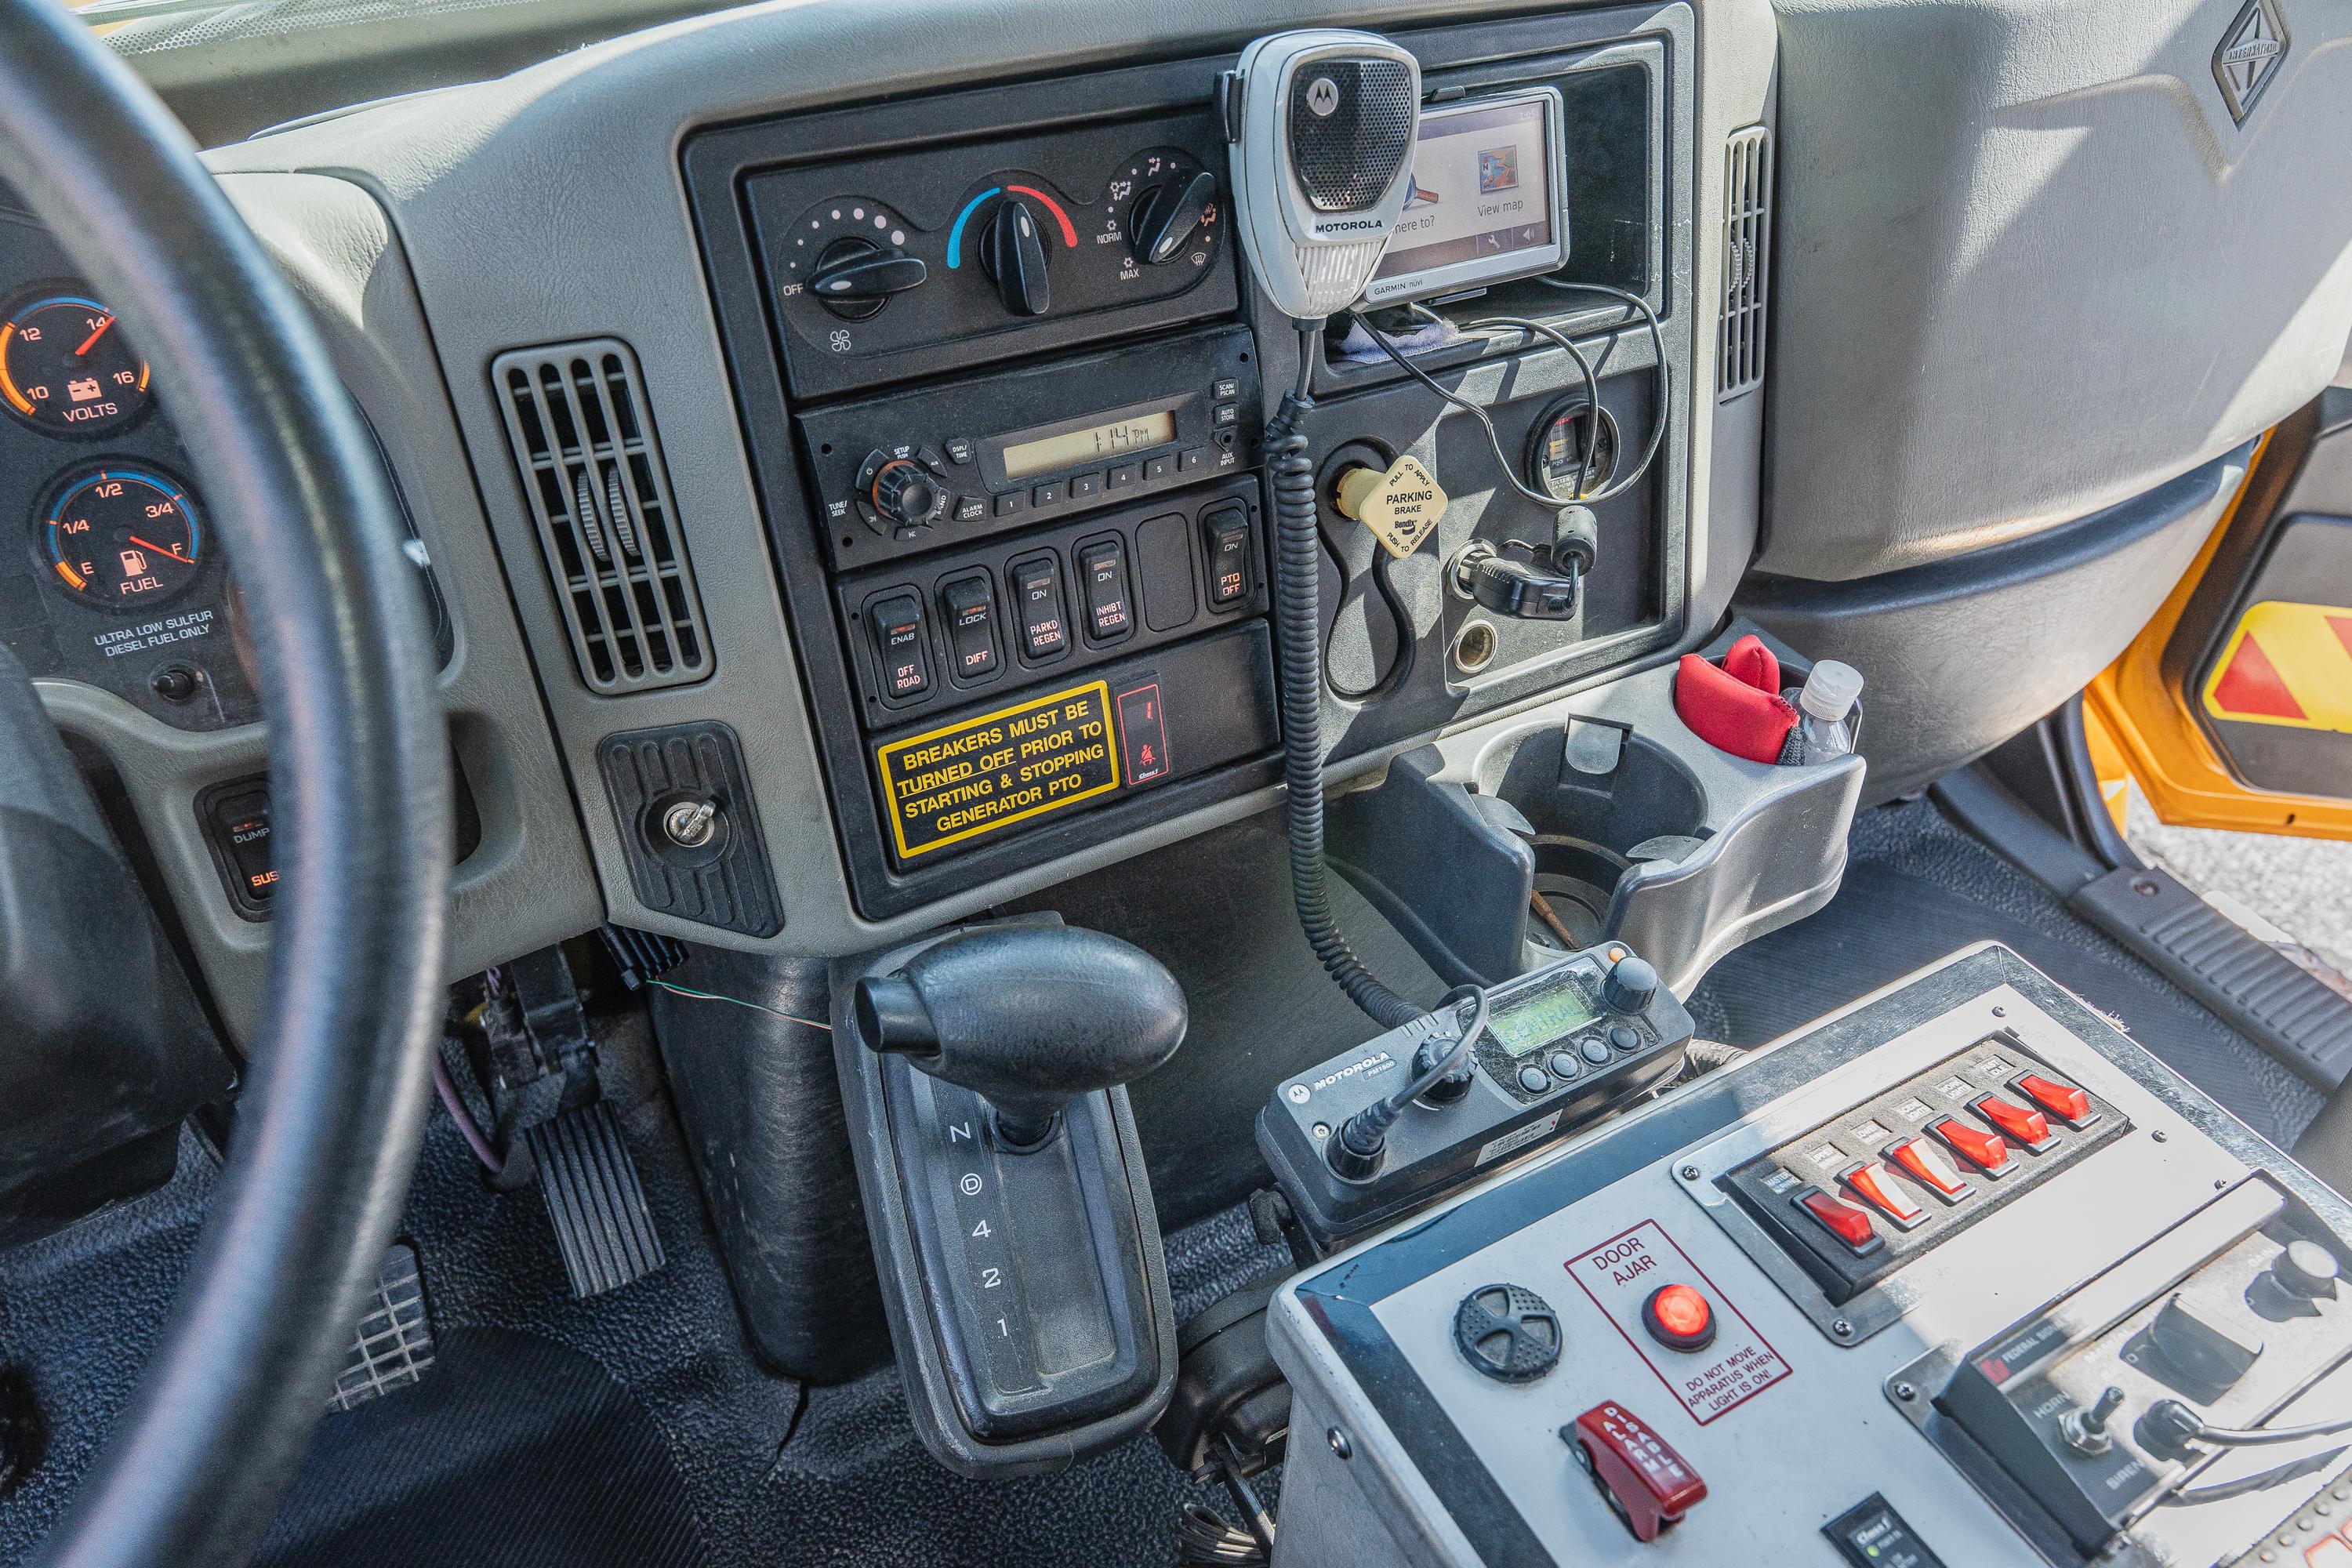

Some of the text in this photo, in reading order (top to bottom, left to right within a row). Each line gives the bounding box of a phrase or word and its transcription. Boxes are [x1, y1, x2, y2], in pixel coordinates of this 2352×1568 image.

[1478, 199, 1523, 216] View map
[1316, 220, 1383, 234] MOTOROLA
[1421, 215, 1435, 228] to?
[1097, 231, 1122, 245] NORM
[1120, 268, 1139, 280] MAX
[783, 283, 804, 296] OFF
[1374, 278, 1423, 296] GARMIN nüvi
[86, 316, 107, 331] 14
[20, 327, 42, 343] 12
[113, 371, 135, 385] 16
[27, 386, 49, 401] 10
[1219, 383, 1235, 391] SCAN/
[1220, 388, 1236, 397] PSCAN
[63, 402, 118, 423] VOLTS
[1221, 408, 1234, 416] AUTO
[894, 445, 909, 455] SETUP
[1220, 457, 1236, 466] INPUT
[1389, 471, 1403, 486] PULL
[1414, 470, 1430, 486] APPLY
[95, 482, 123, 499] 1/2
[1386, 490, 1432, 505] PARKING
[145, 503, 174, 520] 3/4
[828, 500, 848, 511] TUNE/
[832, 508, 846, 517] SEEK
[937, 495, 946, 515] BND
[962, 503, 983, 514] ALARM
[1395, 504, 1421, 515] BRAKE
[963, 510, 982, 518] CLOCK
[63, 518, 90, 535] 1/4
[1395, 519, 1415, 528] Bendix
[1386, 532, 1400, 547] PUSH
[1410, 518, 1433, 546] RELEASE
[172, 543, 183, 556] F
[1224, 542, 1239, 552] ON
[82, 561, 94, 575] E
[1098, 571, 1112, 582] ON
[1221, 572, 1240, 586] PTO
[120, 577, 165, 595] FUEL
[1222, 583, 1240, 596] OFF
[1032, 589, 1047, 601] ON
[1096, 601, 1122, 616] INHIBT
[959, 612, 986, 626] LOCK
[1098, 612, 1126, 627] REGEN
[94, 610, 214, 647] ULTRA LOW SULFUR
[1030, 620, 1058, 635] PARKD
[105, 623, 211, 658] DIESEL FUEL ONLY
[891, 633, 915, 645] ENAB
[1033, 630, 1061, 647] REGEN
[965, 651, 988, 666] DIFF
[898, 665, 914, 677] OFF
[897, 675, 920, 689] ROAD
[903, 700, 1089, 771] BREAKERS MUST BE
[897, 720, 1102, 795] TURNED OFF PRIOR TO
[905, 744, 1104, 818] STARTING & STOPPING
[936, 773, 1082, 832] GENERATOR PTO
[233, 827, 270, 844] DUMP
[1314, 1051, 1390, 1090] MOTOROLA
[1367, 1061, 1394, 1076] PM1500
[950, 1122, 971, 1142] N
[1764, 1171, 1792, 1187] MASTER
[972, 1220, 991, 1238] 4
[1592, 1237, 1646, 1271] DOOR
[982, 1268, 1001, 1288] 2
[1612, 1255, 1657, 1286] AJAR
[996, 1318, 1007, 1336] 1
[2002, 1336, 2039, 1363] FEDERAL
[1686, 1346, 1757, 1392] DO NOT MOVE
[1687, 1351, 1775, 1408] APPARATUS WHEN
[1708, 1369, 1773, 1411] LIGHT IS ON!
[2033, 1392, 2071, 1418] HORN
[1602, 1421, 1661, 1472] ALARM
[1603, 1406, 1685, 1478] DISABLE
